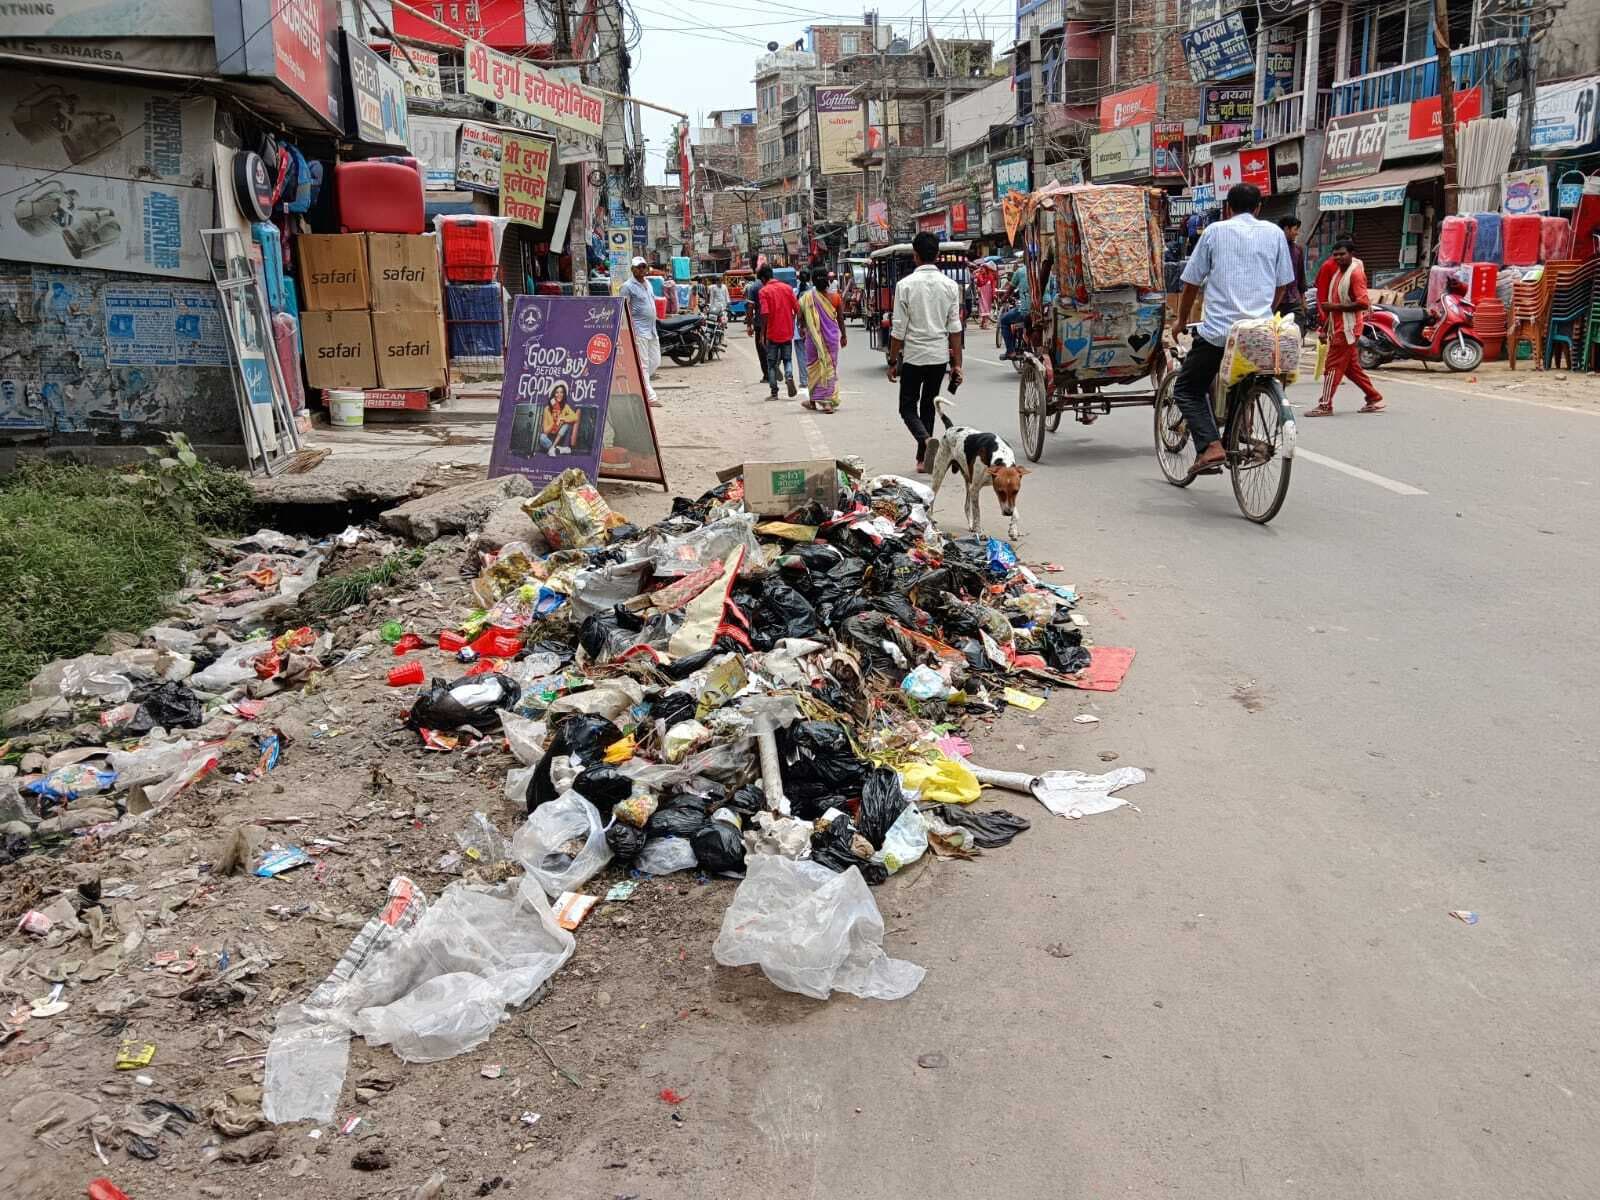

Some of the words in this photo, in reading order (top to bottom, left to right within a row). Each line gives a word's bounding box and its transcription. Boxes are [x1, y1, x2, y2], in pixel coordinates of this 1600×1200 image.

[49, 42, 125, 61] SAHARSA
[411, 49, 438, 65] Studio
[469, 45, 489, 85] श्री
[492, 58, 523, 100] दुर्गा
[481, 131, 502, 146] Studi
[1326, 121, 1360, 160] मेला
[504, 139, 522, 166] श्री
[523, 147, 550, 175] दुर्गा
[150, 191, 170, 269] ADVENTURE
[311, 268, 357, 285] safari
[382, 265, 426, 282] safari
[317, 342, 362, 359] safari
[387, 340, 431, 358] safari
[527, 343, 567, 367] GOOD
[562, 357, 588, 378] BUY
[534, 364, 562, 377] BEFORE
[363, 392, 406, 400] ERICAN
[518, 373, 555, 399] GOOD
[572, 379, 598, 403] BYE
